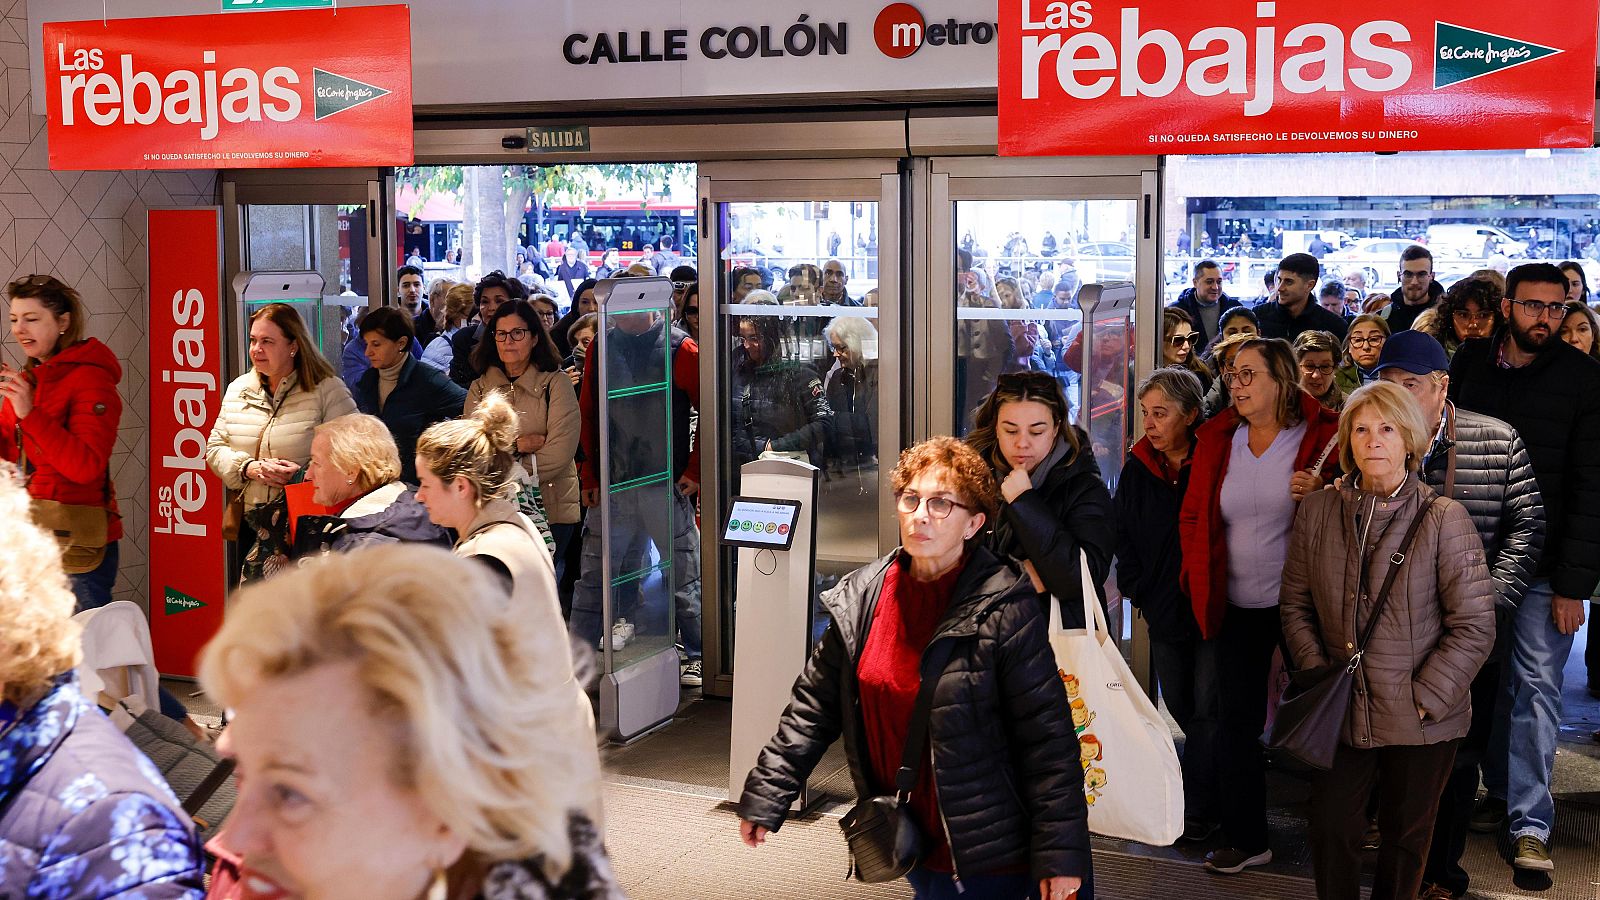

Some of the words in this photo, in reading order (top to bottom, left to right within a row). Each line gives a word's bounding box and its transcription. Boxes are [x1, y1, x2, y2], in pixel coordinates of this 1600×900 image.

[1021, 0, 1093, 30] Las
[562, 29, 688, 65] CALLE
[699, 13, 848, 60] COLÓN
[892, 18, 998, 47] metro
[58, 42, 103, 71] Las
[1021, 1, 1413, 117] rebajas
[1440, 46, 1453, 59] El
[1454, 46, 1484, 59] Corte
[1485, 42, 1530, 63] Inglés
[60, 50, 302, 141] rebajas
[317, 87, 325, 97] El
[326, 87, 344, 97] Corte
[531, 131, 584, 148] SALIDA
[1148, 134, 1158, 143] SI
[1160, 134, 1175, 143] NO
[1176, 134, 1211, 143] QUEDA
[1212, 133, 1273, 142] SATISFECHO
[1276, 132, 1288, 141] LE
[1291, 131, 1359, 141] DEVOLVEMOS
[1361, 131, 1376, 140] SU
[1378, 130, 1419, 139] DINERO
[183, 152, 221, 160] SATISFECHO
[222, 152, 231, 160] LE
[274, 151, 284, 159] SU
[284, 151, 309, 159] DINERO
[163, 288, 216, 537] rebajas
[154, 486, 172, 534] Las
